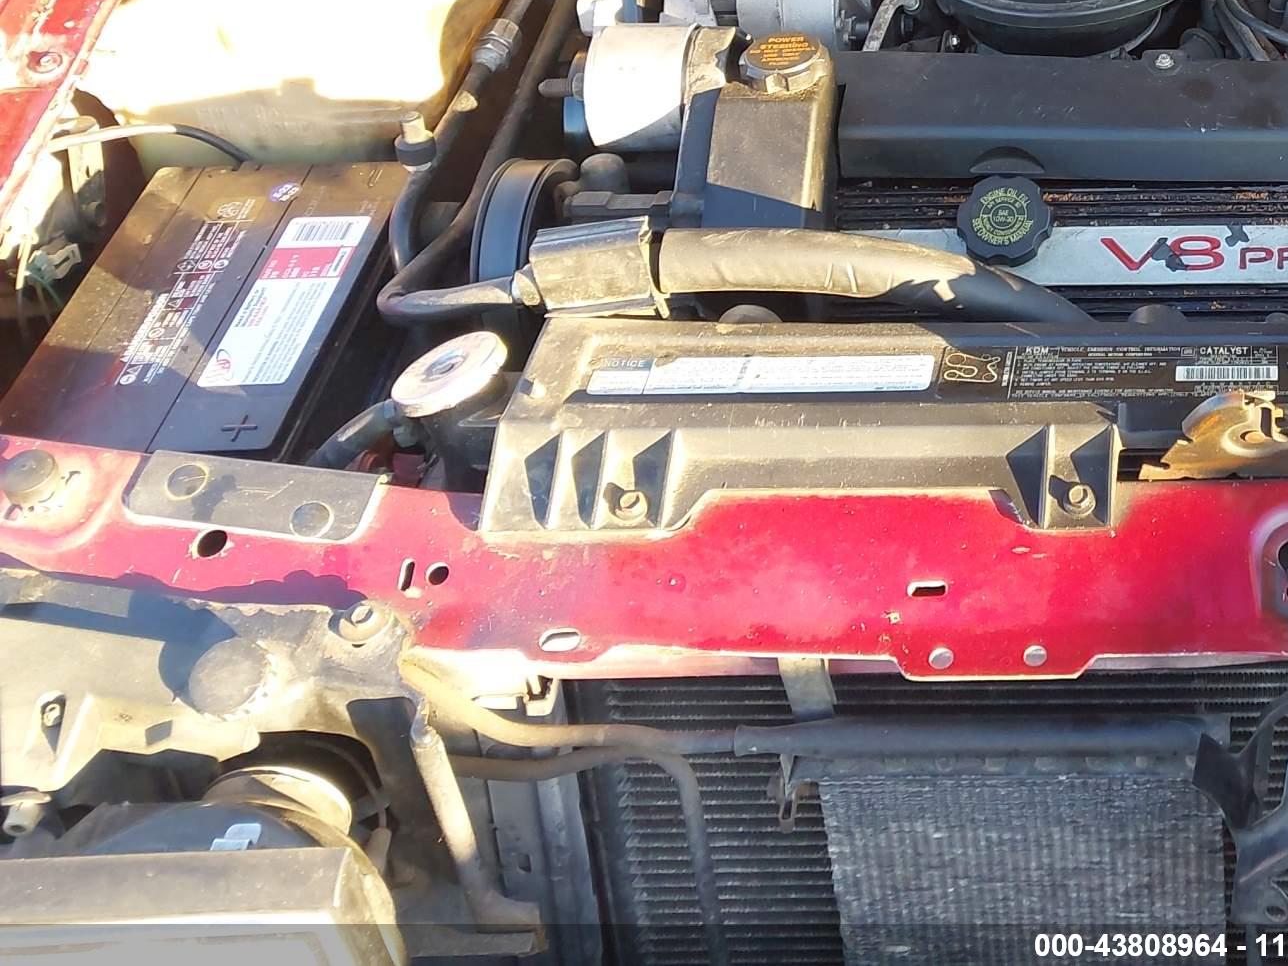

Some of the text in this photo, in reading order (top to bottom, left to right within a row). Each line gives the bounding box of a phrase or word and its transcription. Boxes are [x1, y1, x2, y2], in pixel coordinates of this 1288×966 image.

[980, 188, 1005, 205] ENGINE
[1007, 188, 1017, 198] OIL
[1101, 236, 1225, 271] V8
[1200, 347, 1248, 355] CATALYST
[607, 359, 645, 368] NOTICE
